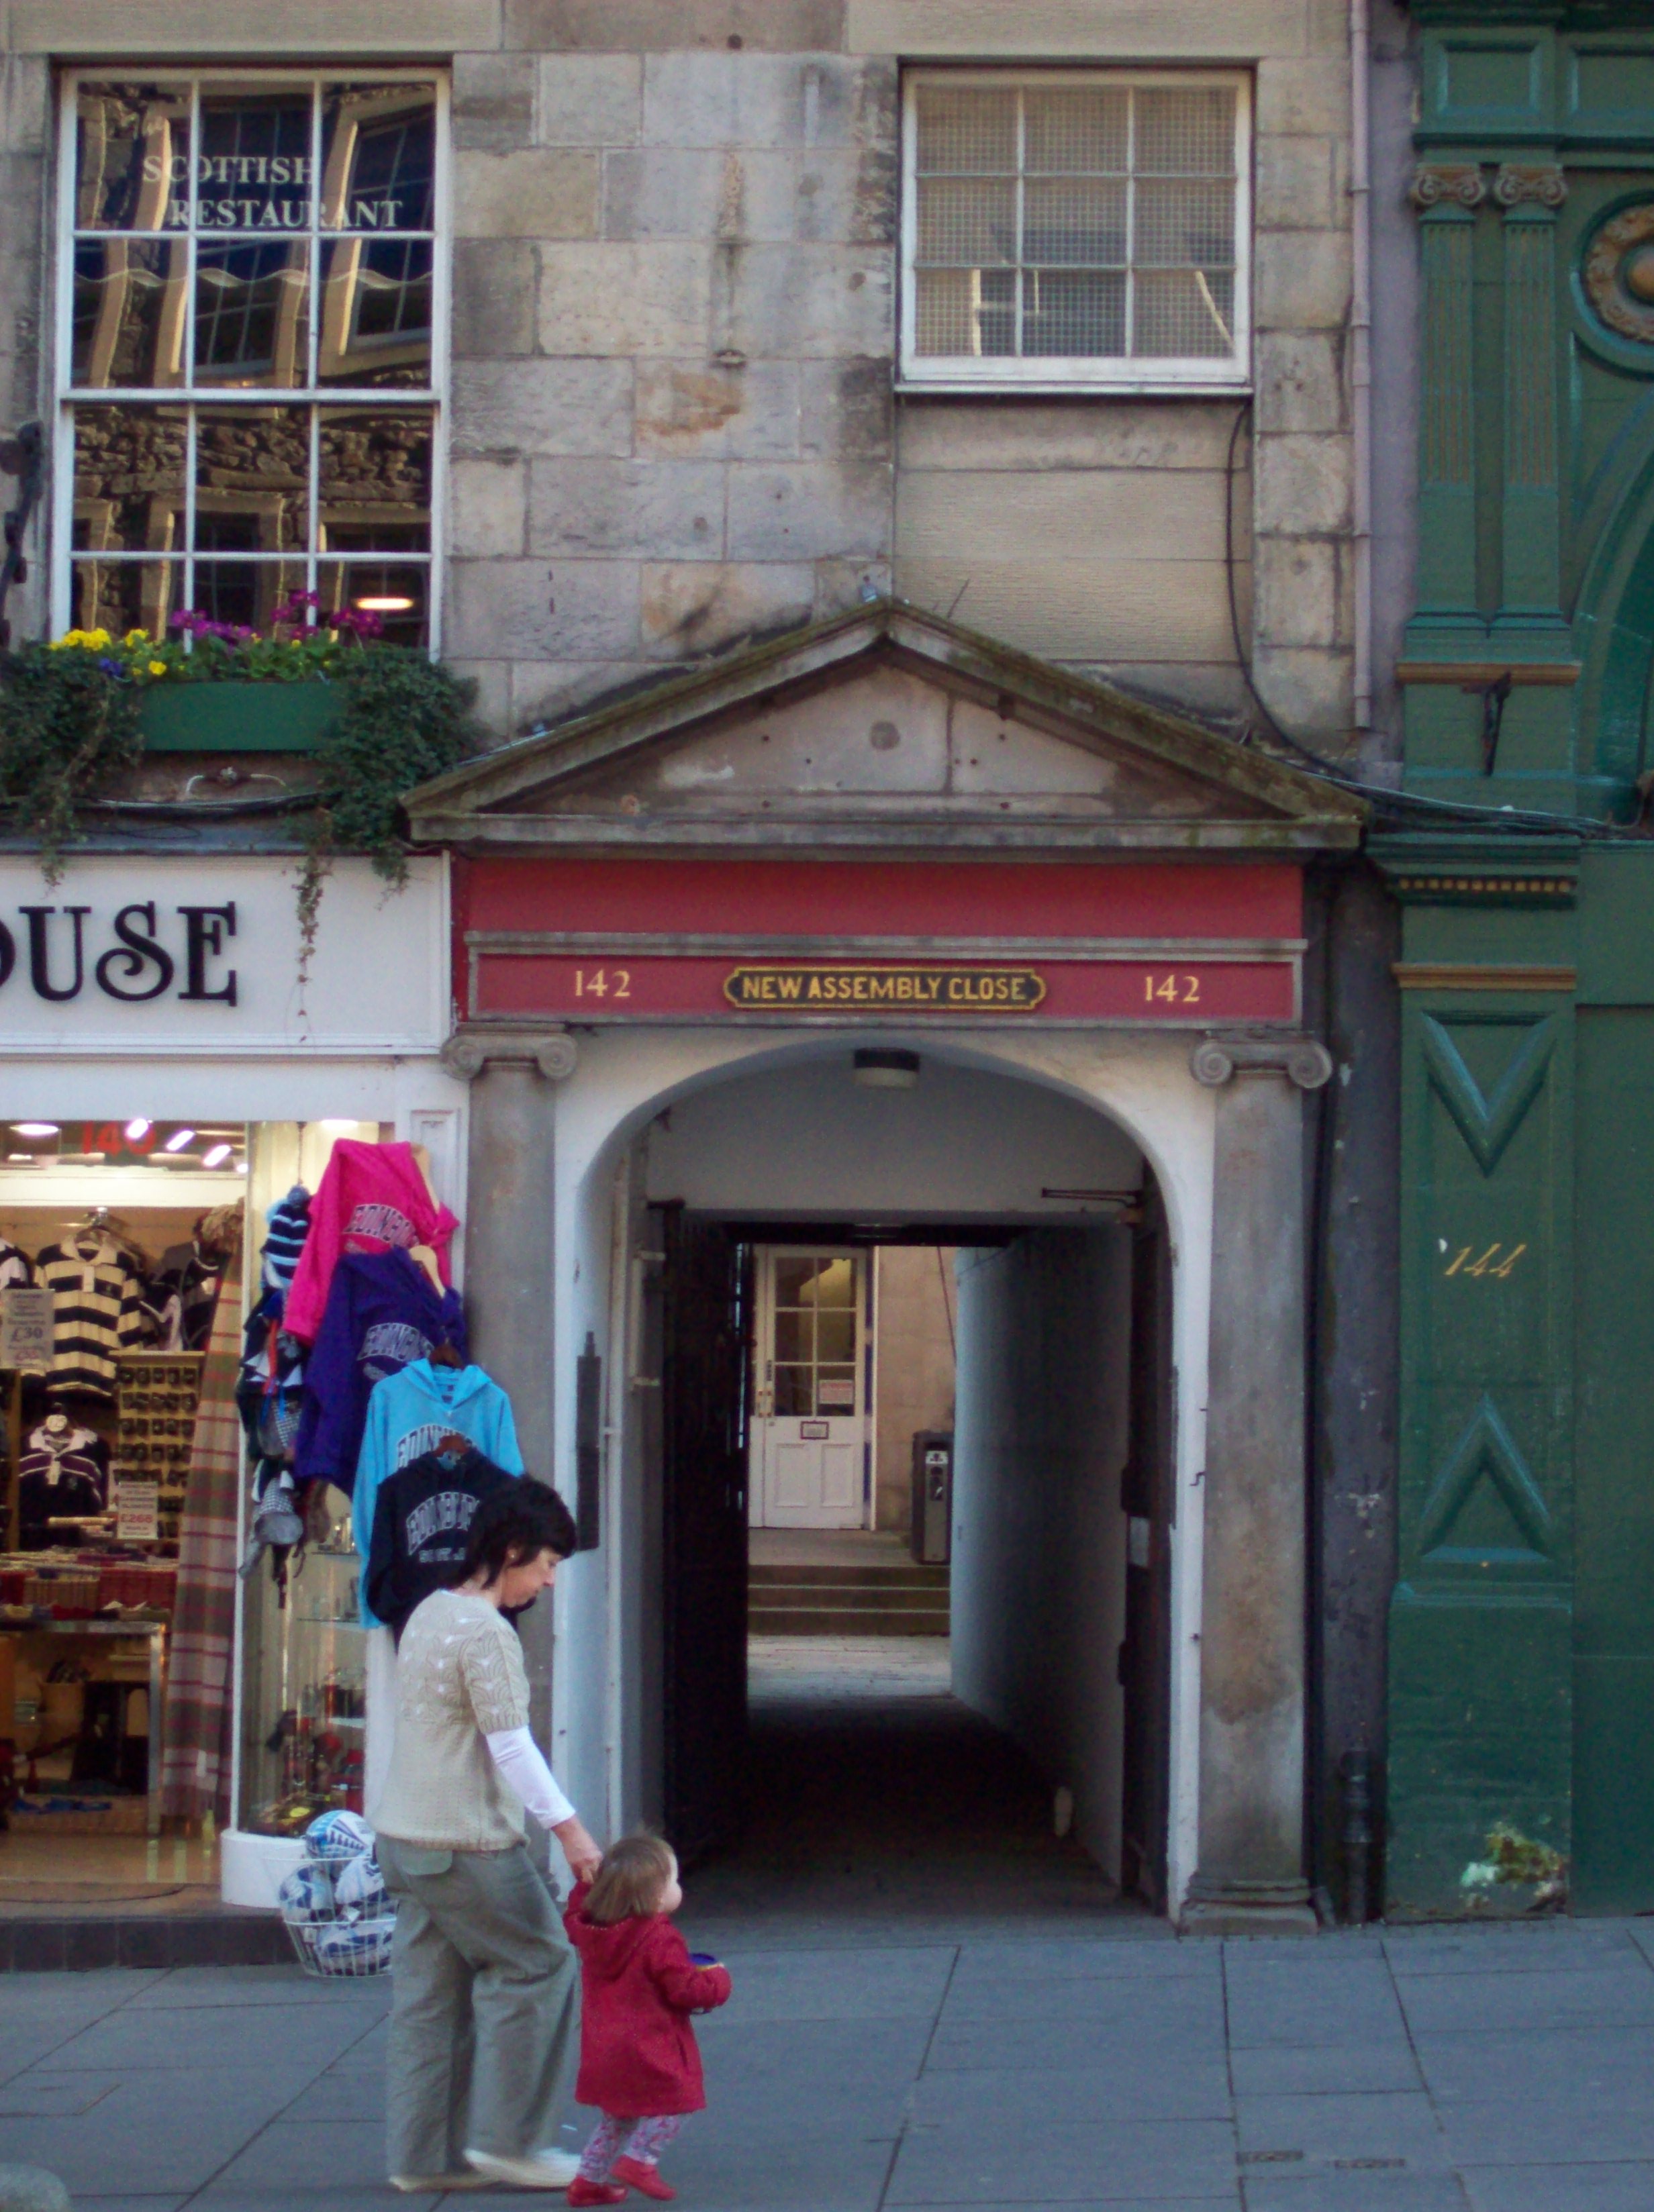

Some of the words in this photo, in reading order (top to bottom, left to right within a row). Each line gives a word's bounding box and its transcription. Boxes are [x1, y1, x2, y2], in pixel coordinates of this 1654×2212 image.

[143, 156, 314, 185] SCOTTISH
[169, 199, 403, 228] RESTAURANT
[0, 901, 238, 1007] USE
[575, 970, 630, 997] 142
[742, 976, 803, 999] NEW
[807, 976, 942, 999] ASSEMBLY
[948, 977, 1027, 1001] CLOSE
[1145, 974, 1200, 1002] 142
[81, 1120, 157, 1157] 140
[1445, 1243, 1527, 1278] 144
